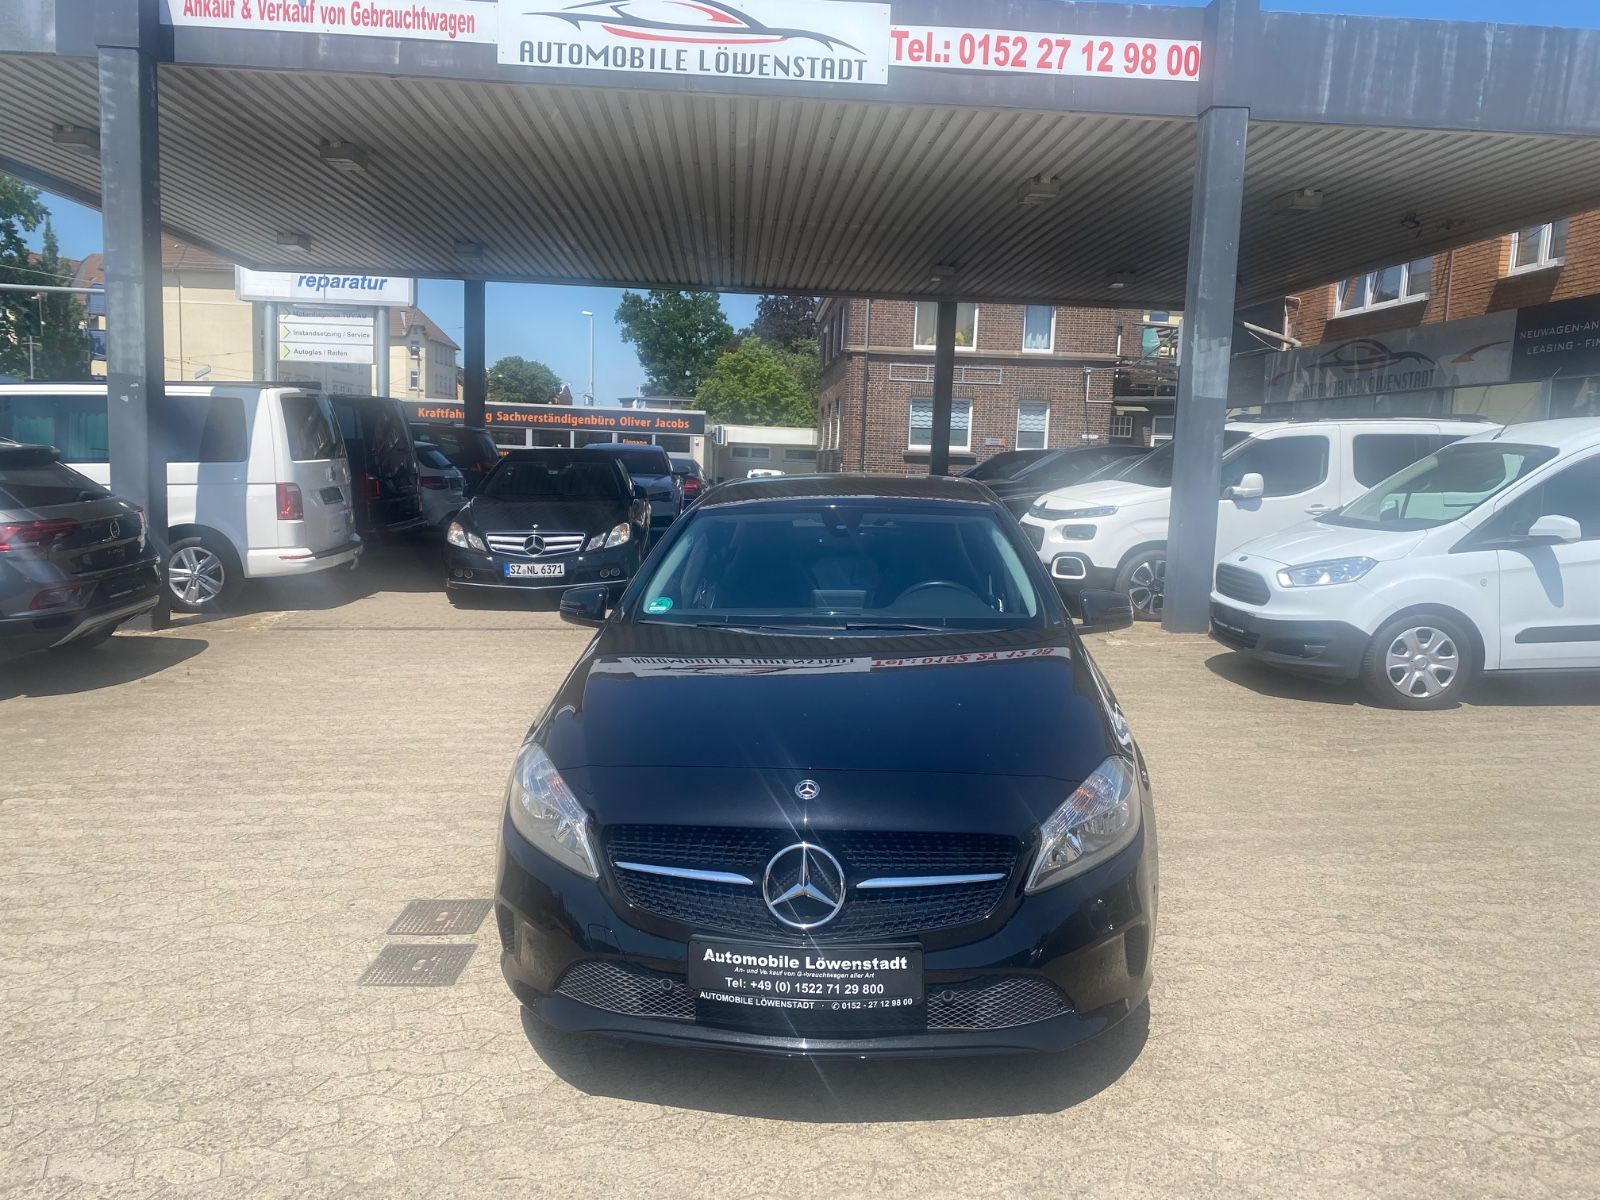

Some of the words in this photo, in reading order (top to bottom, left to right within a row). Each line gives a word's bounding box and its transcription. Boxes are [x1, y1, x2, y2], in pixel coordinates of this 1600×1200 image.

[183, 0, 235, 18] Ankauf
[241, 0, 251, 19] &
[257, 0, 315, 23] Verkauf
[320, 6, 345, 25] von
[350, 1, 475, 38] Gebrauchtwagen
[519, 40, 688, 71] AUTOMOBILE
[699, 46, 868, 81] LÖWENSTADT
[890, 30, 951, 63] Tel.:
[959, 33, 1027, 68] 0152
[1036, 38, 1071, 69] 27
[1081, 40, 1114, 72] 12
[1123, 43, 1157, 75] 98
[1166, 45, 1200, 77] 00
[298, 274, 388, 291] reparatur
[1527, 341, 1574, 355] LEASING
[418, 408, 493, 422] Kraftfahrg
[496, 411, 616, 426] Sachverständigenbüro
[619, 416, 651, 428] Oliver
[655, 418, 690, 429] Jacobs
[510, 565, 522, 574] SZ
[527, 565, 538, 574] NL
[540, 565, 563, 574] 6371
[703, 949, 799, 968] Automobile
[805, 956, 907, 970] Löwenstadt
[725, 977, 747, 989] Tel:
[750, 980, 772, 991] +49
[775, 980, 791, 993] (0)
[795, 982, 823, 994] 1522
[827, 984, 840, 994] 71
[845, 984, 859, 994] 29
[862, 984, 884, 994] 800
[700, 991, 754, 1006] AUTOMOBILE
[756, 996, 815, 1009] LÖWENSTADT
[842, 1001, 861, 1009] 0152
